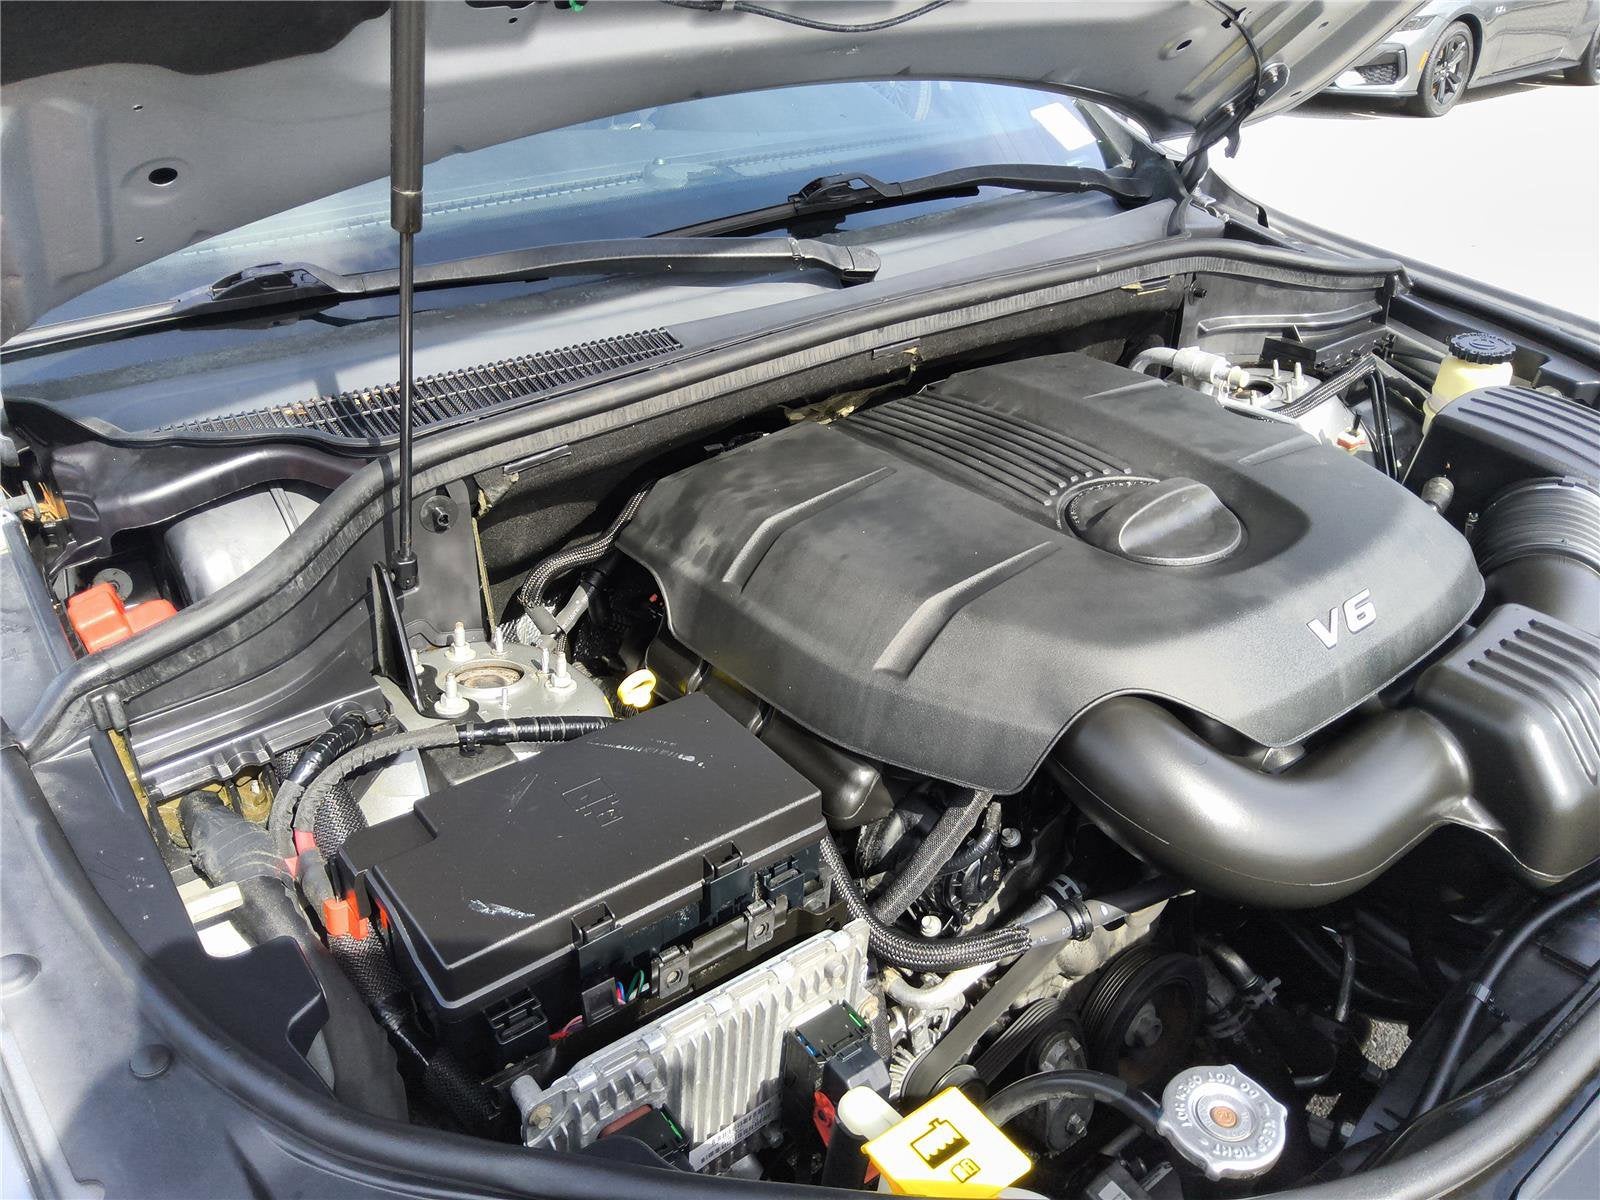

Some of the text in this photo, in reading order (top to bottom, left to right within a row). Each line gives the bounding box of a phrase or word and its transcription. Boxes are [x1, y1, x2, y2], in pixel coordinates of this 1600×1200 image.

[1306, 587, 1377, 650] V6
[1208, 1071, 1236, 1086] NOT
[1212, 1142, 1257, 1160] TIGHT
